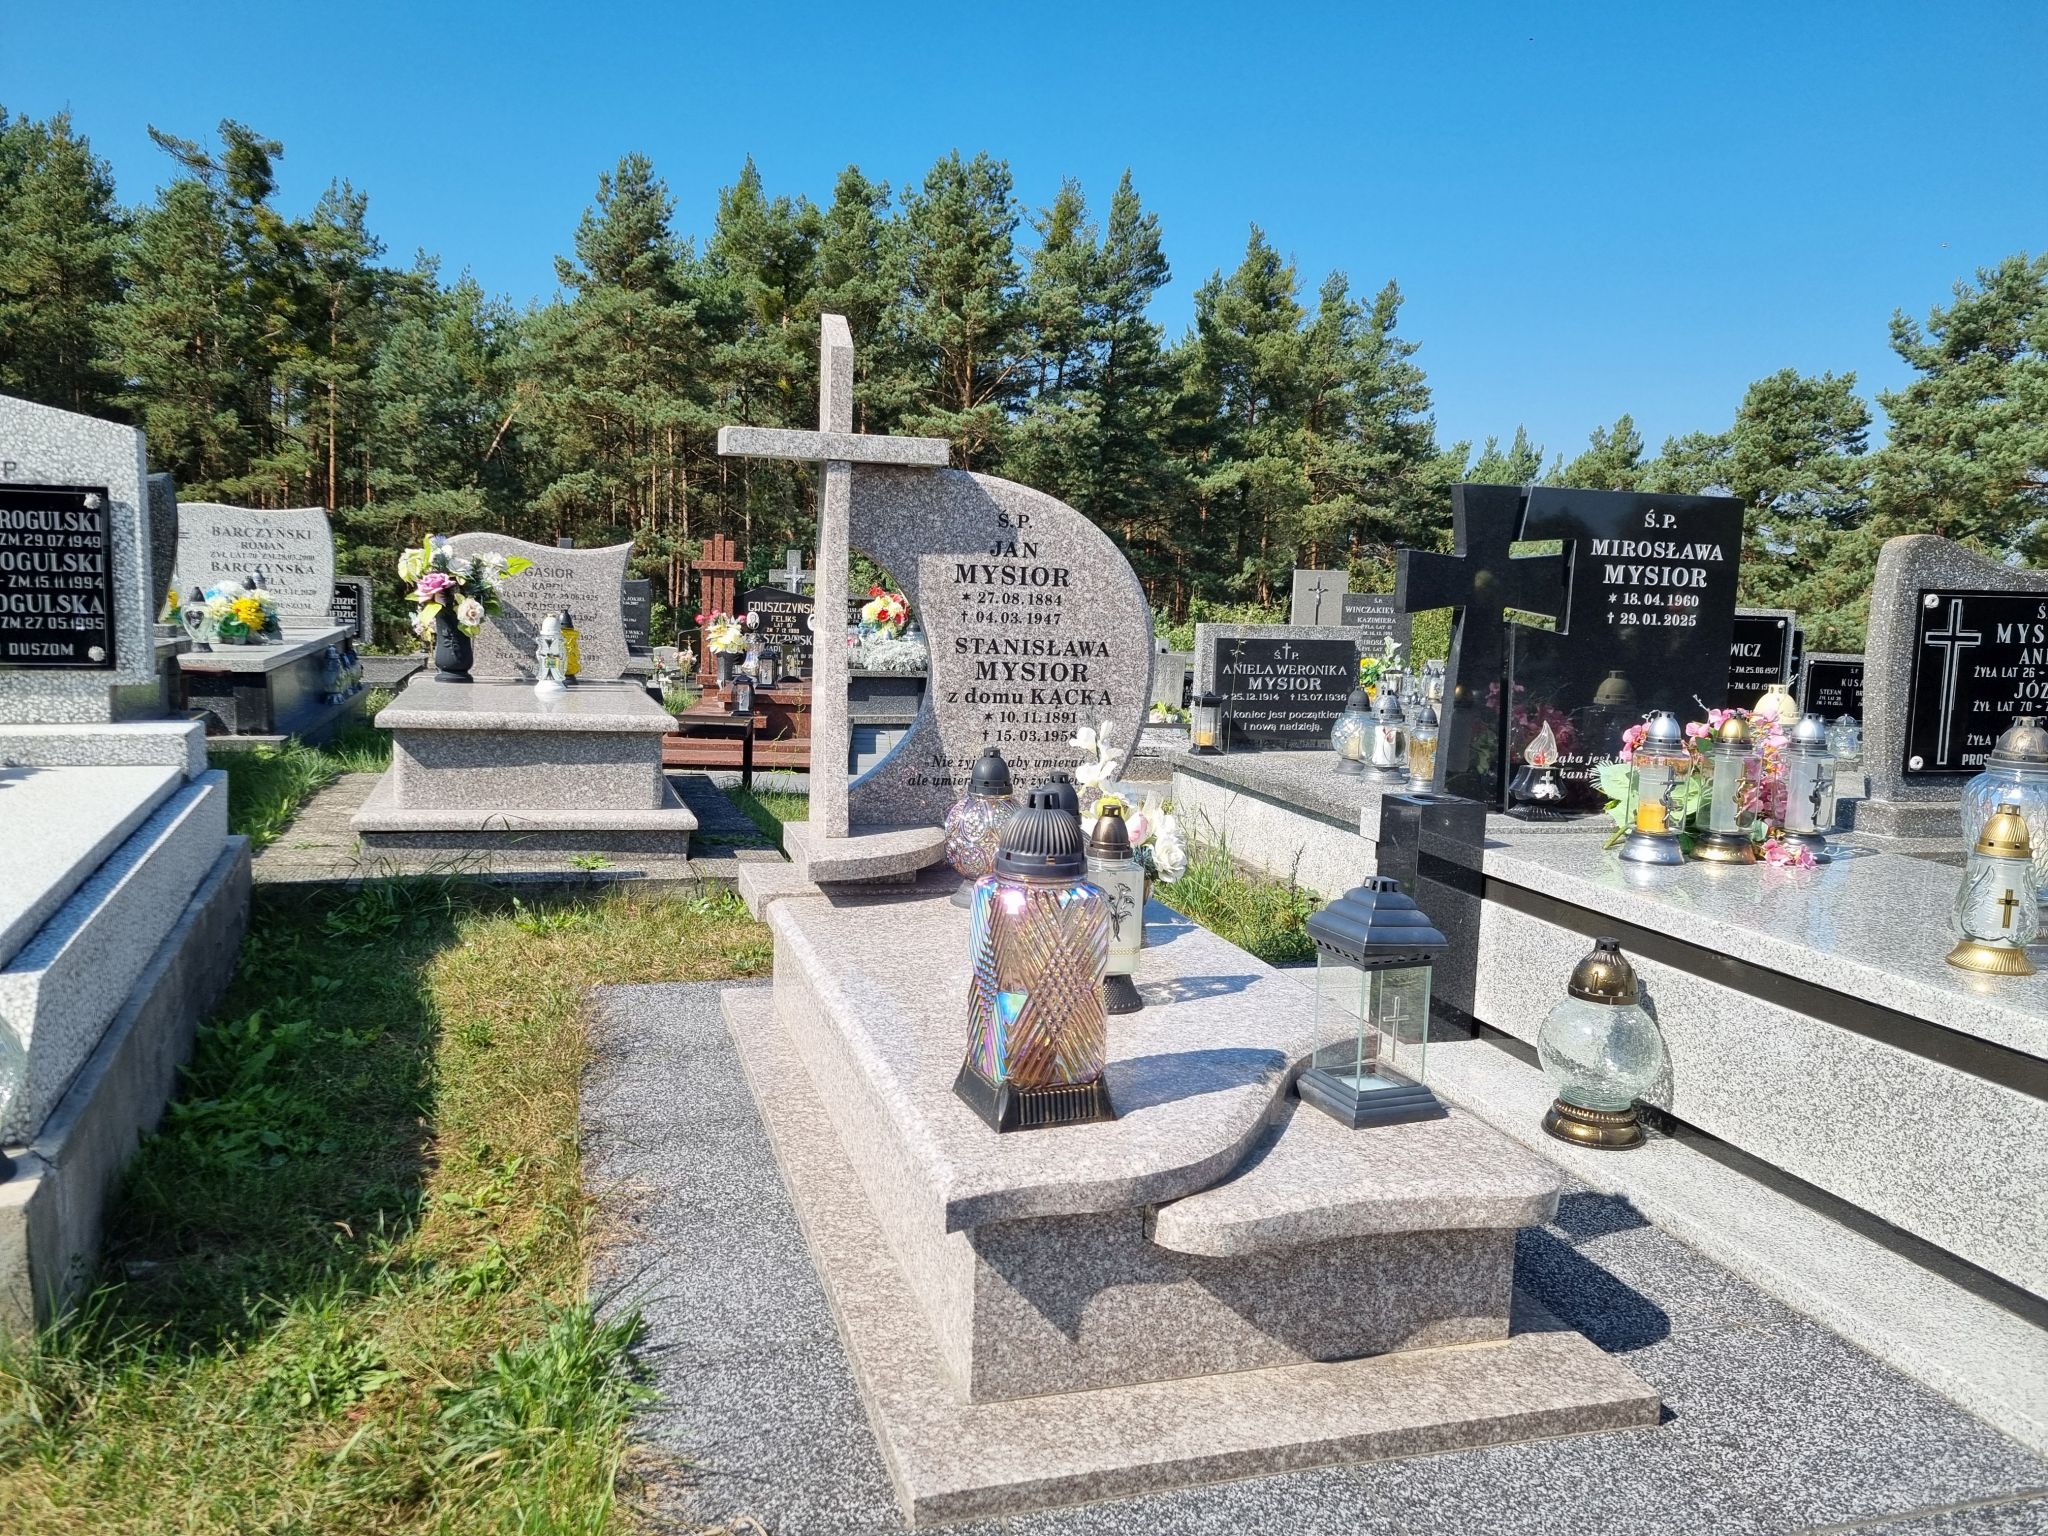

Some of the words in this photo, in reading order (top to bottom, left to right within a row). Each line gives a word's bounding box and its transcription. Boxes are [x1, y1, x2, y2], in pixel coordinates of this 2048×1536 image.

[0, 509, 101, 532] ROGULSKI
[240, 541, 286, 550] ROMAN
[990, 541, 1039, 558] JAN
[1590, 538, 1724, 561] MIROSŁAWA
[954, 563, 1070, 587] MYSIOR
[1602, 564, 1707, 588] MYSIOR
[978, 592, 1063, 606] 27.08.1884
[1623, 592, 1699, 607] 18.04.1960
[976, 611, 1062, 625] 04.03.1947
[1620, 612, 1697, 627] 29.01.2025
[9, 642, 75, 656] DUSZOM
[955, 638, 1110, 658] STANISŁAWA
[1730, 643, 1761, 657] WICZ
[975, 662, 1090, 683] MYSIOR
[1222, 664, 1274, 675] ANIELA
[1277, 664, 1348, 676] WERONIKA
[1974, 665, 1997, 678] ŻYŁA
[2001, 667, 2018, 678] LAT
[2022, 668, 2035, 678] 26
[1248, 677, 1322, 690] MYSIOR
[949, 691, 960, 704] z
[965, 687, 1023, 704] domu
[1030, 688, 1113, 710] KĄCKA
[1973, 700, 1990, 712] ŻYŁ
[1997, 701, 2014, 712] LAT
[2020, 701, 2033, 712] 70
[1233, 710, 1266, 719] koniec
[1268, 710, 1287, 720] jest
[1250, 722, 1277, 732] nową
[1967, 733, 1991, 746] ŻYŁA
[1008, 759, 1031, 773] aby
[1961, 753, 1991, 766] PROS
[908, 774, 928, 787] ale
[932, 775, 971, 787] umier
[1013, 774, 1026, 788] by
